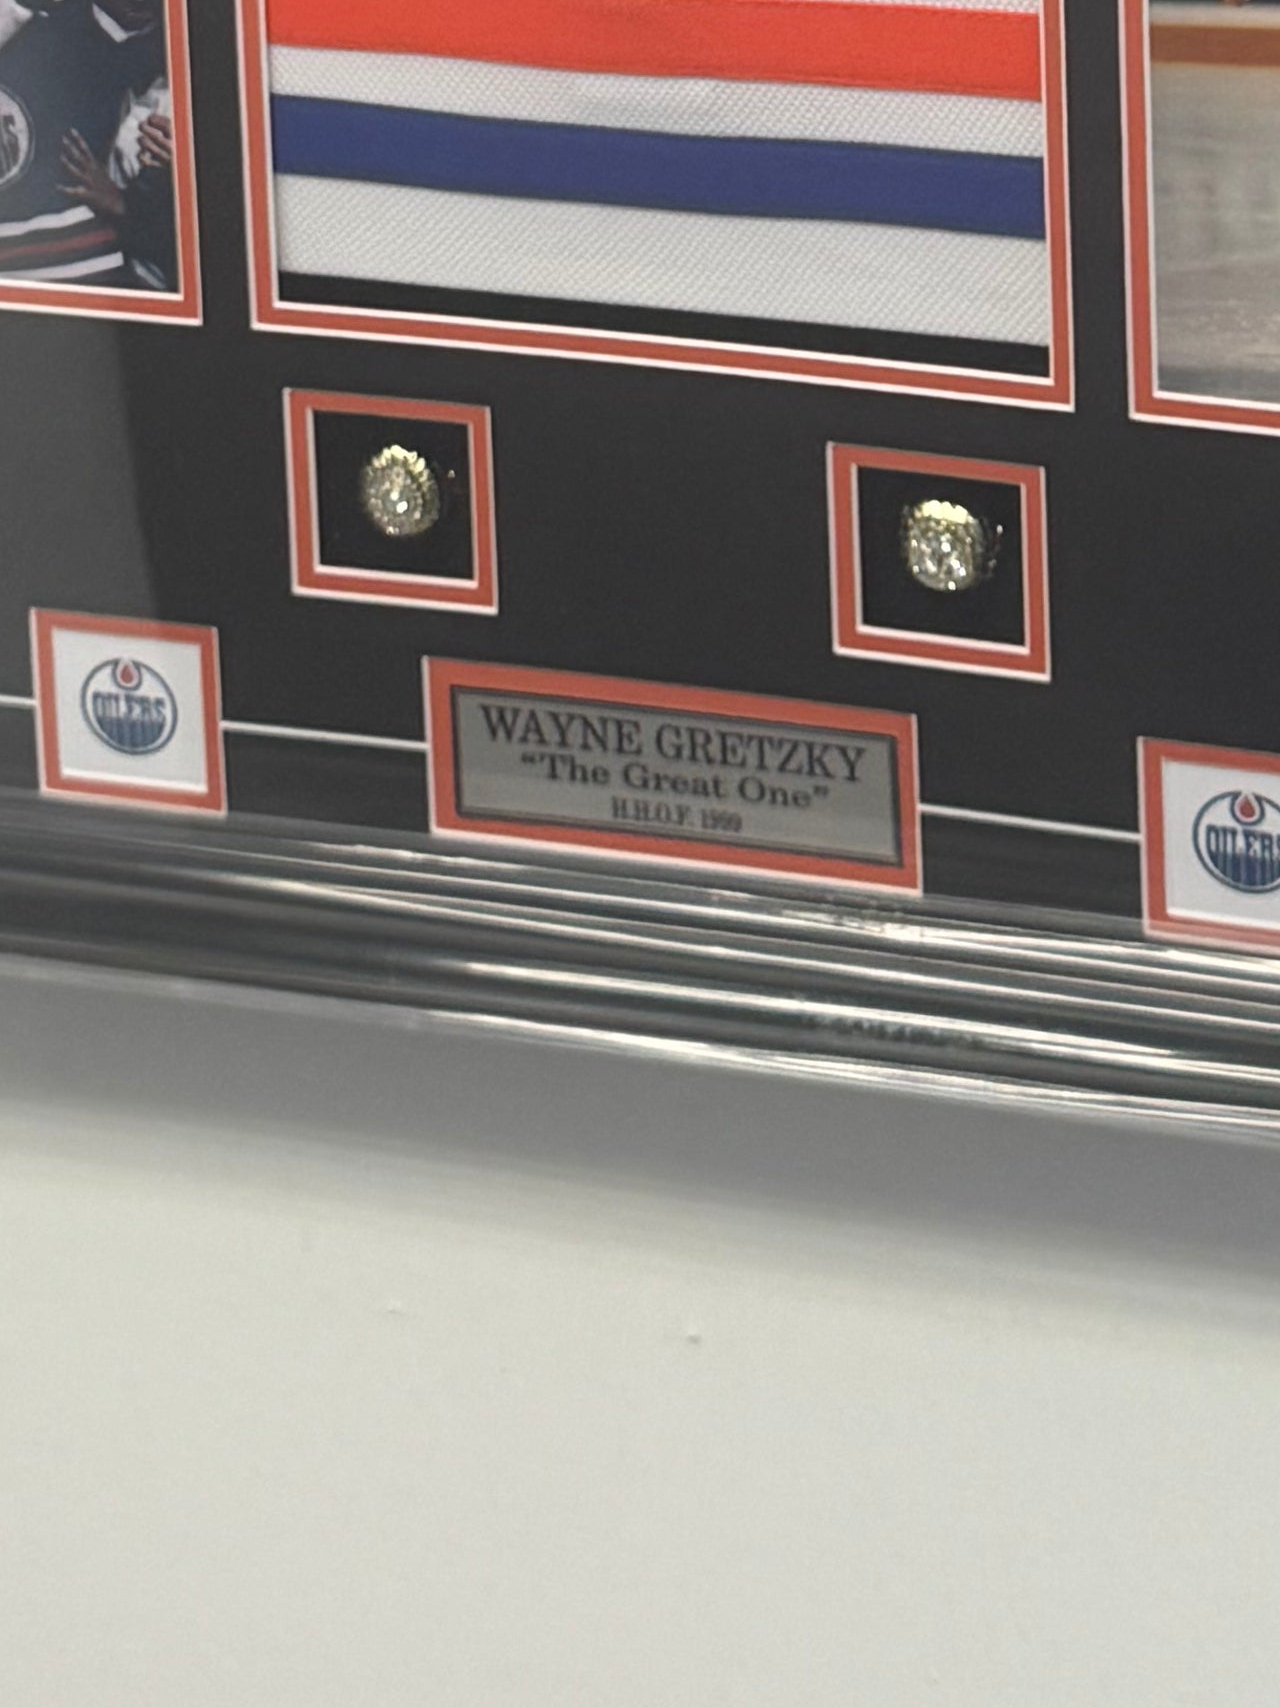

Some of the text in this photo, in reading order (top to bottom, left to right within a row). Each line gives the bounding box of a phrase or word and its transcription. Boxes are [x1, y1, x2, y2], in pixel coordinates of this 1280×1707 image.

[481, 703, 867, 783] WAYNE GRETZKY
[623, 762, 729, 799] Great
